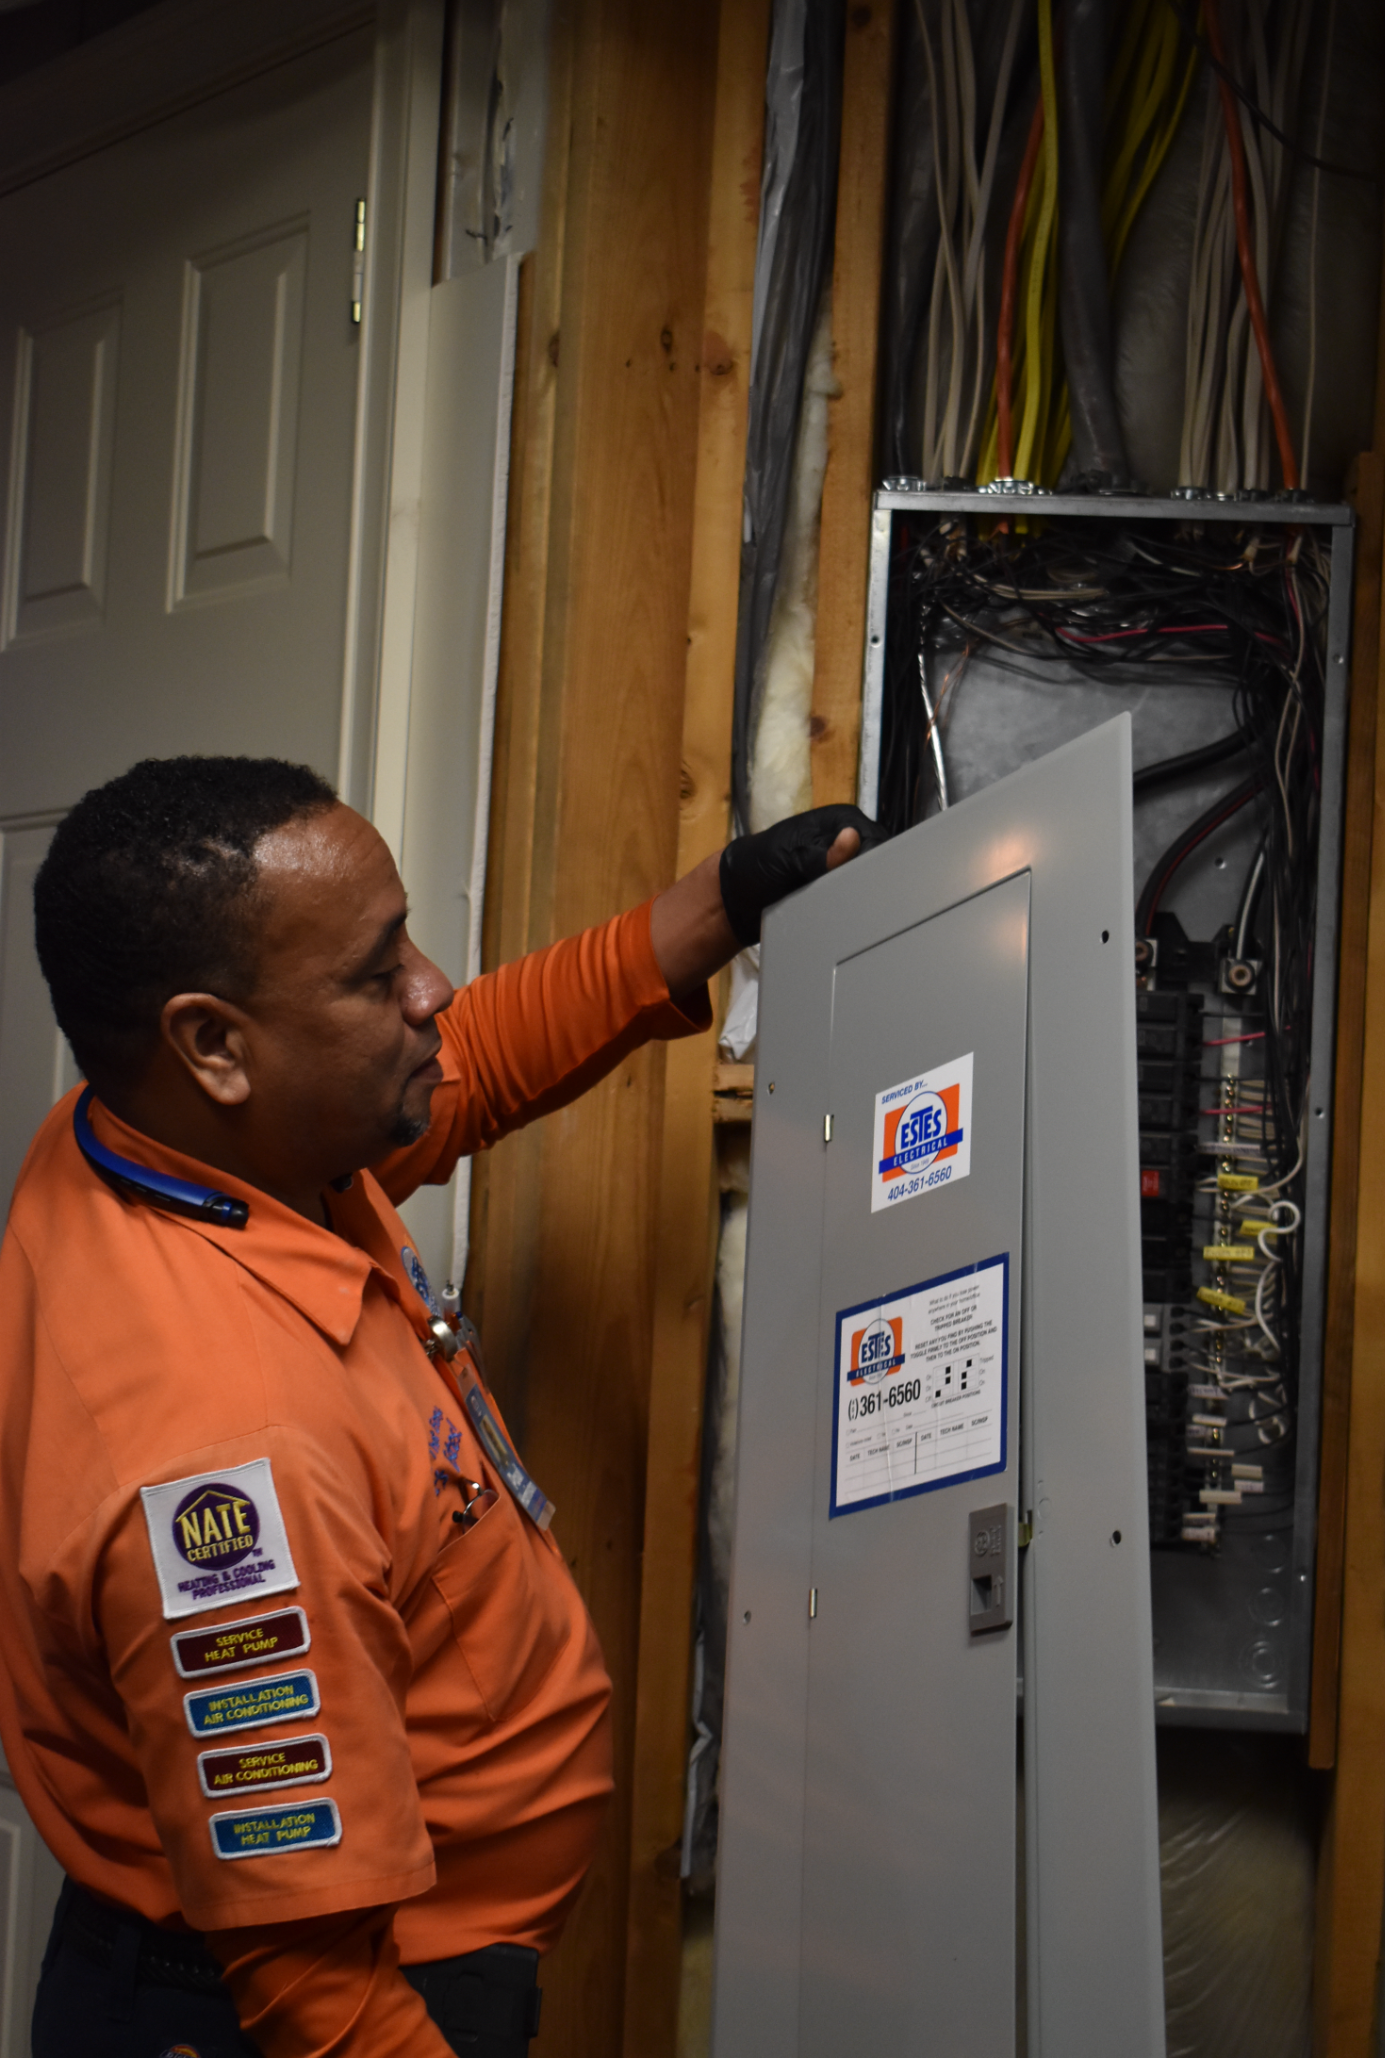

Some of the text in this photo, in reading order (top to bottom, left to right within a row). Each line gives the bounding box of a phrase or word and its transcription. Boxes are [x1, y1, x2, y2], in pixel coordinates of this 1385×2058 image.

[881, 1083, 913, 1105] SERVICED
[901, 1105, 942, 1150] ESTES
[893, 1139, 948, 1167] ELECTRICAL
[887, 1165, 952, 1201] 404-361-6560
[930, 1316, 944, 1324] CHECK
[935, 1314, 973, 1331] TRIPPED BREAKER
[861, 1331, 891, 1363] ESTES
[910, 1350, 926, 1358] TOGGLE
[967, 1330, 987, 1340] POSITION
[915, 1341, 928, 1349] RESET
[964, 1323, 983, 1333] PUSHING
[940, 1427, 951, 1435] TECH
[952, 1423, 964, 1431] NAME
[850, 1453, 860, 1461] DATE
[179, 1500, 251, 1549] NATE
[187, 1534, 254, 1562] CERTIFIED
[177, 1559, 276, 1593] HEATING & COOLING
[192, 1573, 266, 1600] PROFESSIONAL
[204, 1637, 278, 1662] HEAT PUMP
[216, 1628, 264, 1647] SERVICE
[204, 1694, 309, 1725] AIR CONDITIONING
[209, 1685, 294, 1712] INSTALLATION
[214, 1759, 319, 1785] AIR CONDITIONING
[238, 1752, 286, 1769] SERVICE
[233, 1812, 316, 1834] INSTALLATION
[241, 1826, 311, 1845] HEAT PUMP
